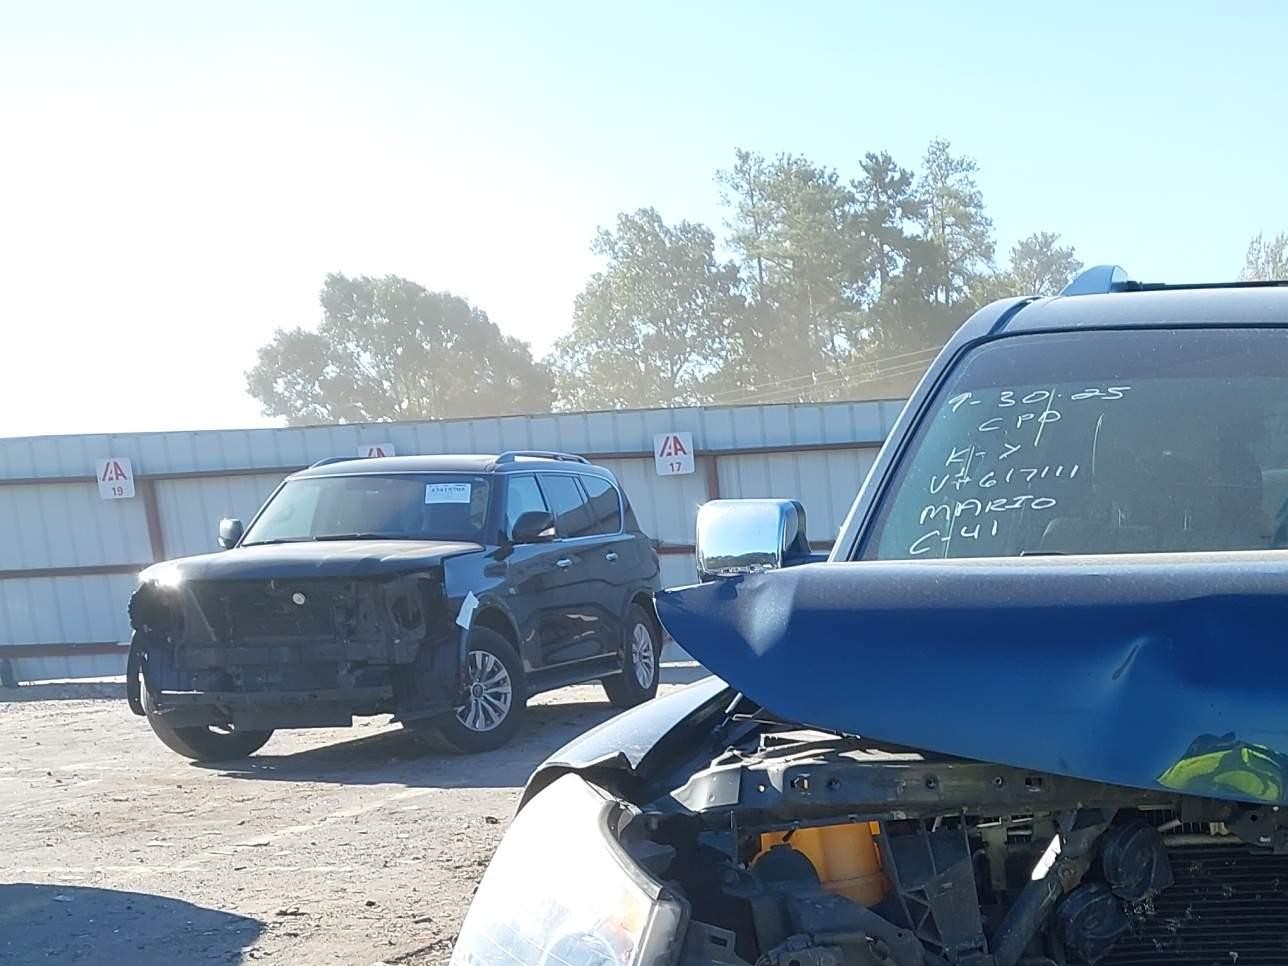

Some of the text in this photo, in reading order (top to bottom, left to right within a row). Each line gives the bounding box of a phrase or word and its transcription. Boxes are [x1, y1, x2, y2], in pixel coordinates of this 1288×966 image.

[668, 461, 682, 473] 17
[111, 486, 124, 497] 19
[919, 495, 1056, 525] MARIO
